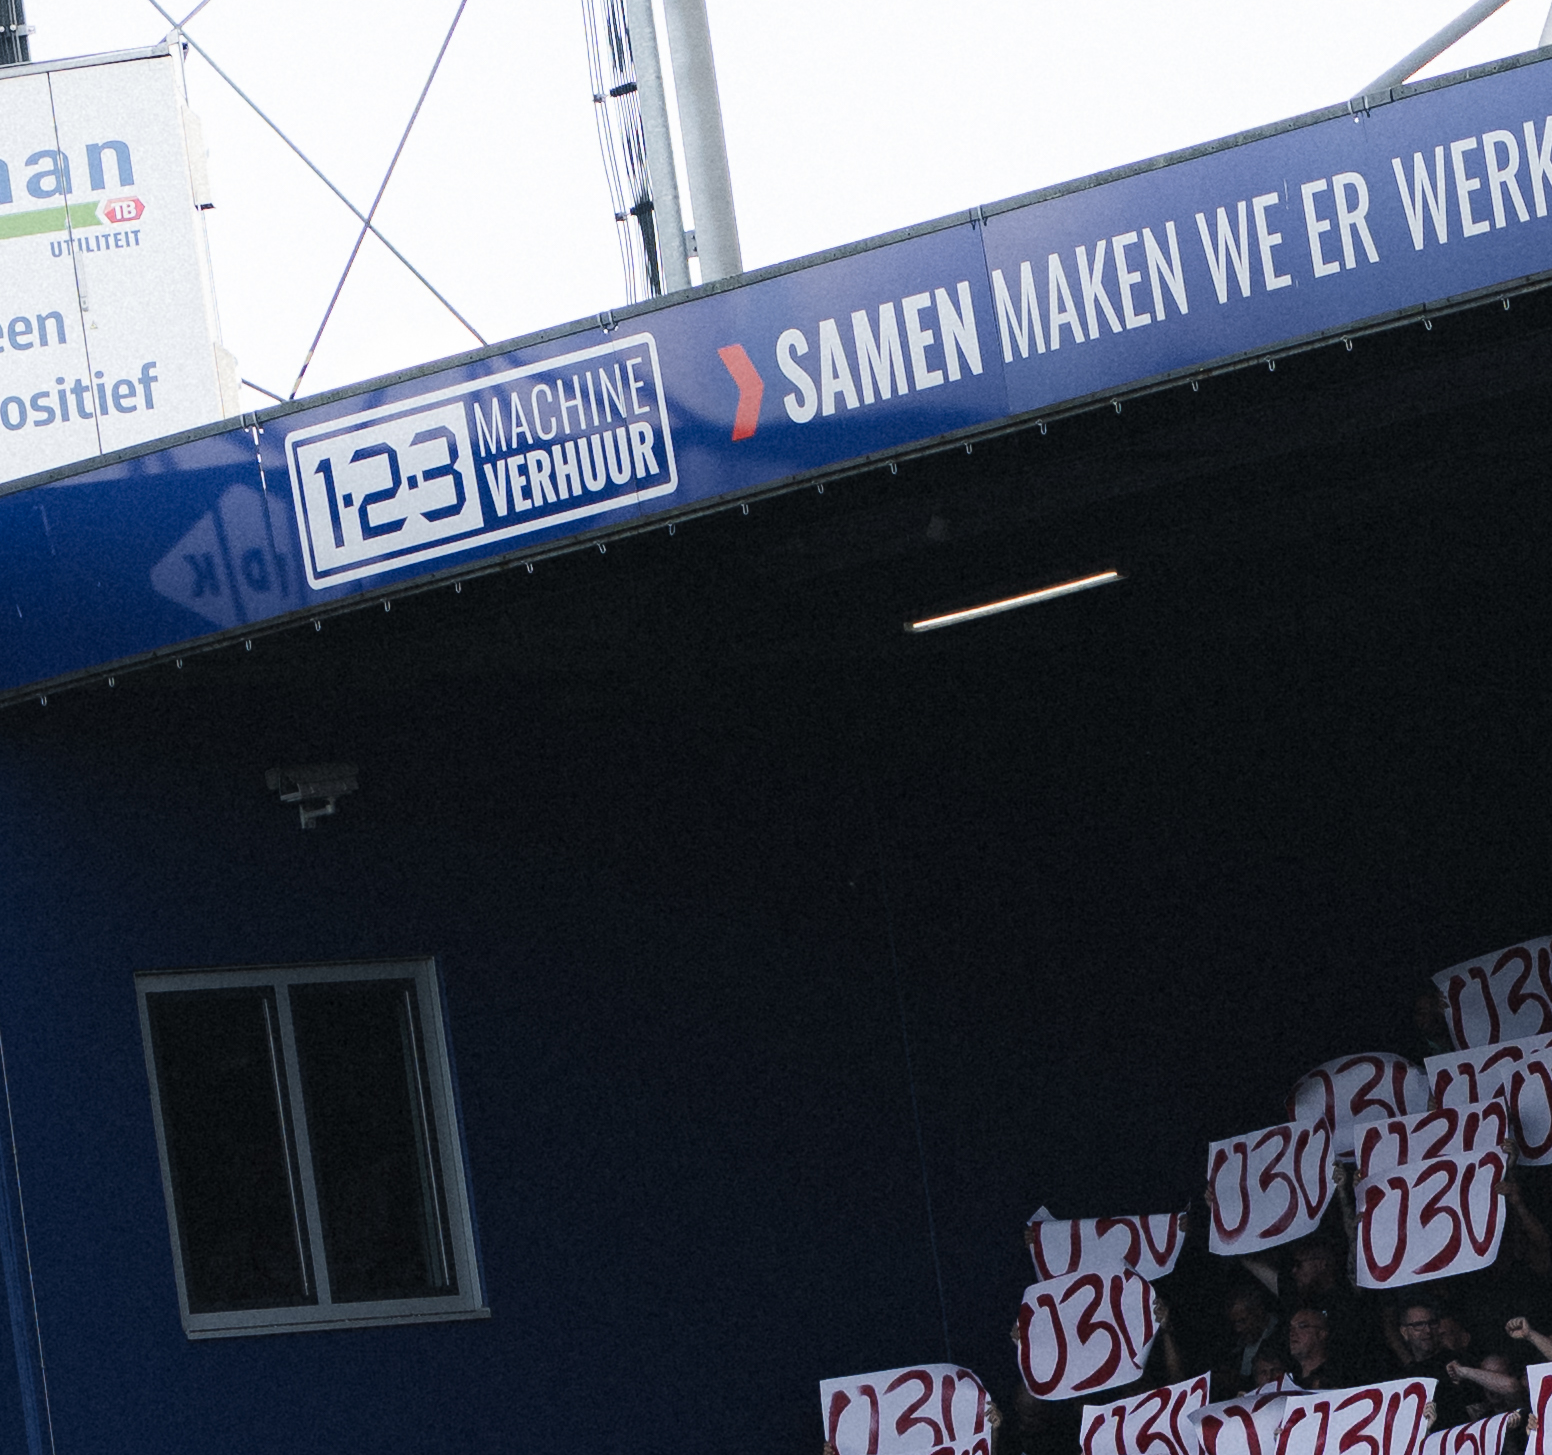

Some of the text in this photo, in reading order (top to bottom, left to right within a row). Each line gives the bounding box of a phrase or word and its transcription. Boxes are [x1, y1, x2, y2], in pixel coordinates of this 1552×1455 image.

[50, 229, 141, 258] UTILITEIT
[110, 201, 137, 221] TB
[0, 310, 67, 354] en
[775, 280, 984, 426] SAMEN
[992, 220, 1189, 364] MAKEN
[1195, 189, 1292, 305] WE
[1299, 169, 1379, 279] ER
[475, 356, 650, 457] MACHINE
[484, 421, 660, 519] VERHUUR
